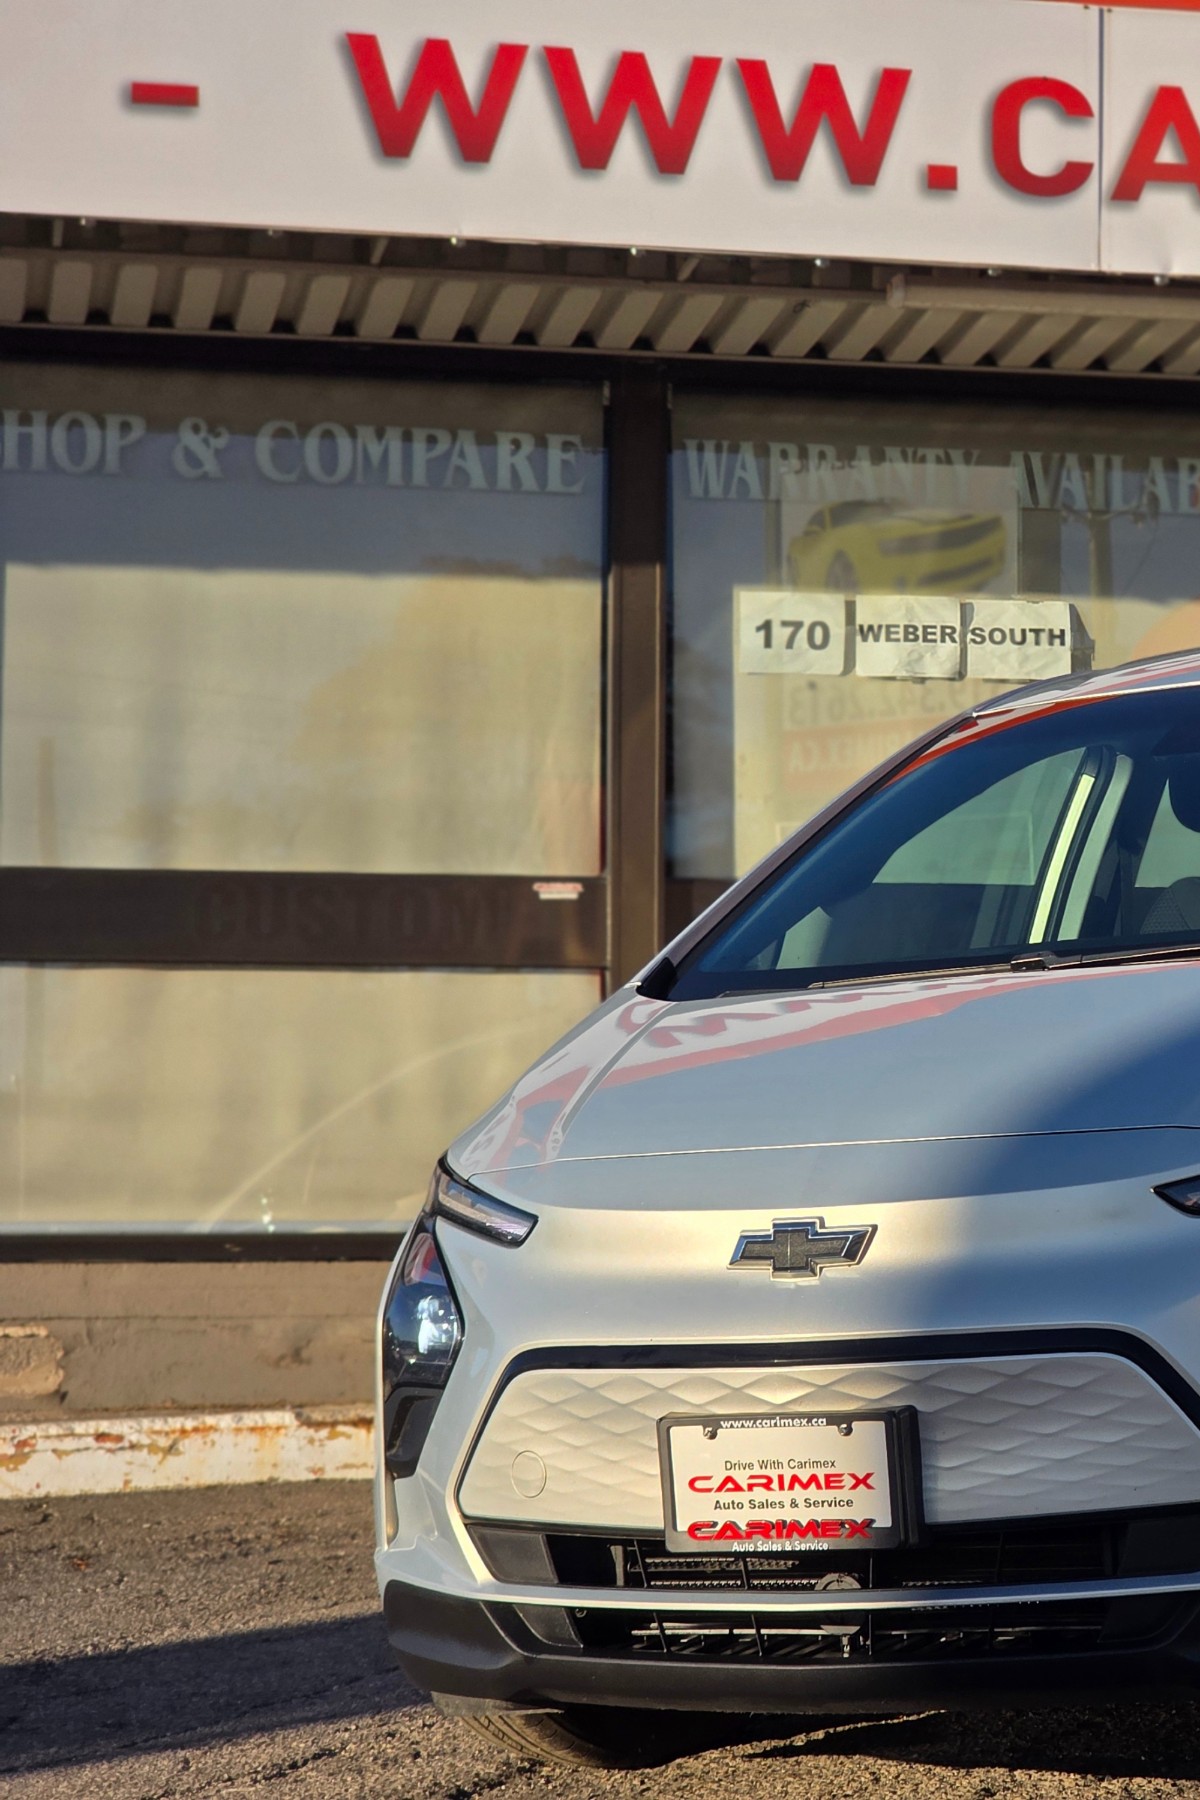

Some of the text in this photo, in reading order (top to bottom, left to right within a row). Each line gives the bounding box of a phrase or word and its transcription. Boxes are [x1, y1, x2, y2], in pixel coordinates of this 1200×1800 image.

[0, 409, 588, 494] HOP & COMPARE
[684, 439, 981, 502] WARRANTY
[755, 618, 1066, 651] 170 WEBER SOUTH
[720, 1416, 827, 1429] www.carimex.ca
[724, 1457, 836, 1471] Drive With Carimex
[687, 1472, 876, 1493] CARIMEX
[714, 1497, 854, 1511] Auto Sales & Service
[686, 1519, 875, 1541] CARIMEX
[732, 1540, 829, 1553] Auto Sales & Service
